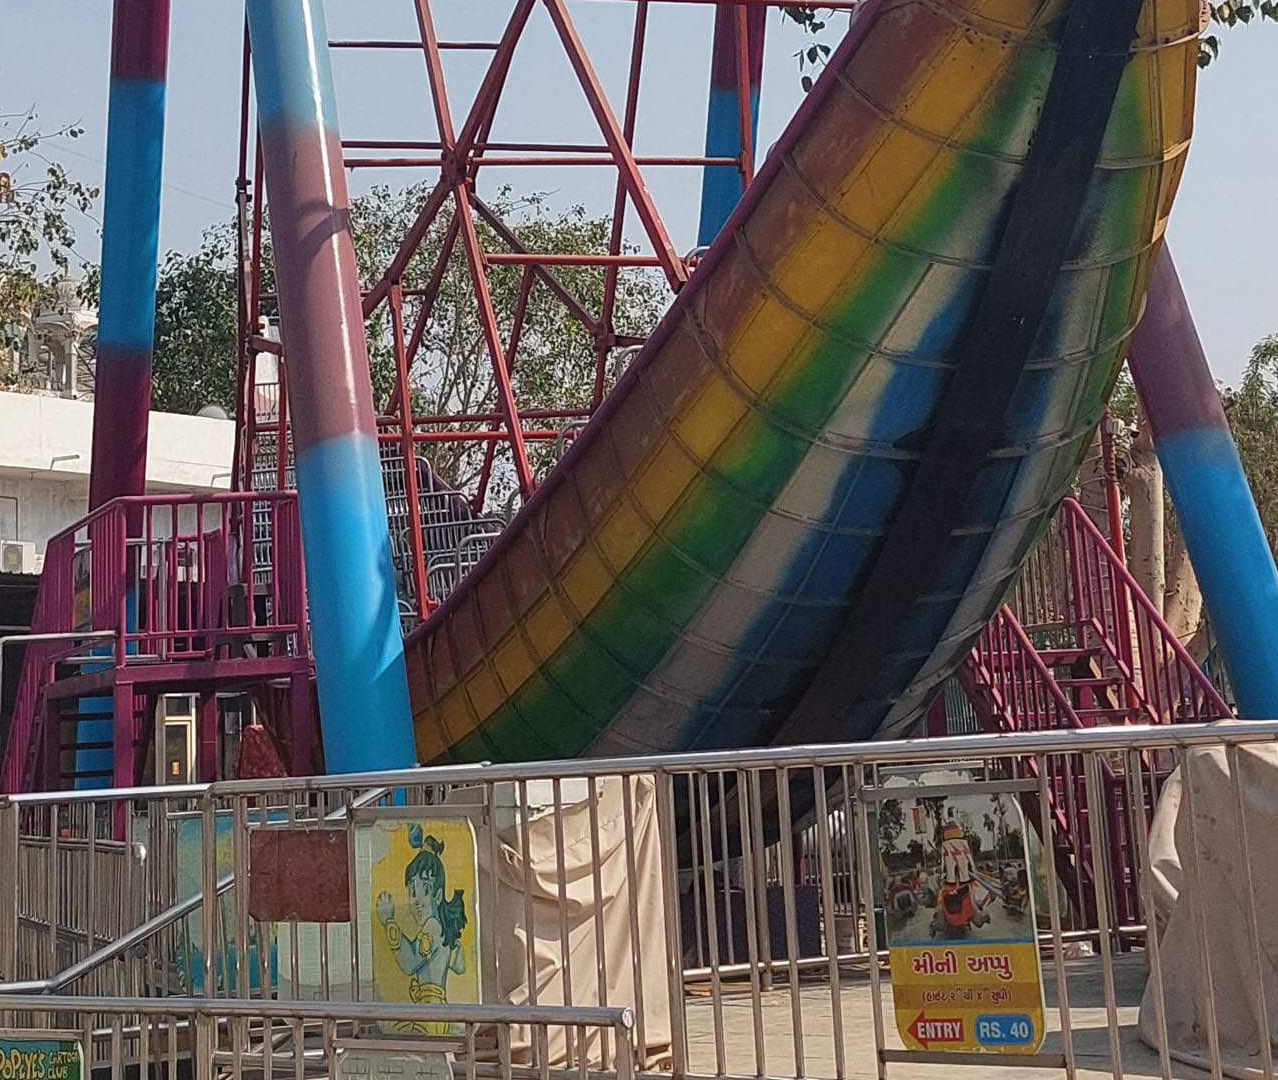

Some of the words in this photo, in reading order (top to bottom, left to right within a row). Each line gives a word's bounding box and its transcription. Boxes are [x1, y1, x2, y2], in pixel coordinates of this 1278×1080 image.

[913, 950, 959, 973] મીની
[967, 954, 1014, 980] અપ્પુ
[917, 1022, 961, 1039] ENTRY
[979, 1022, 1006, 1038] RS.
[1010, 1021, 1029, 1038] 40
